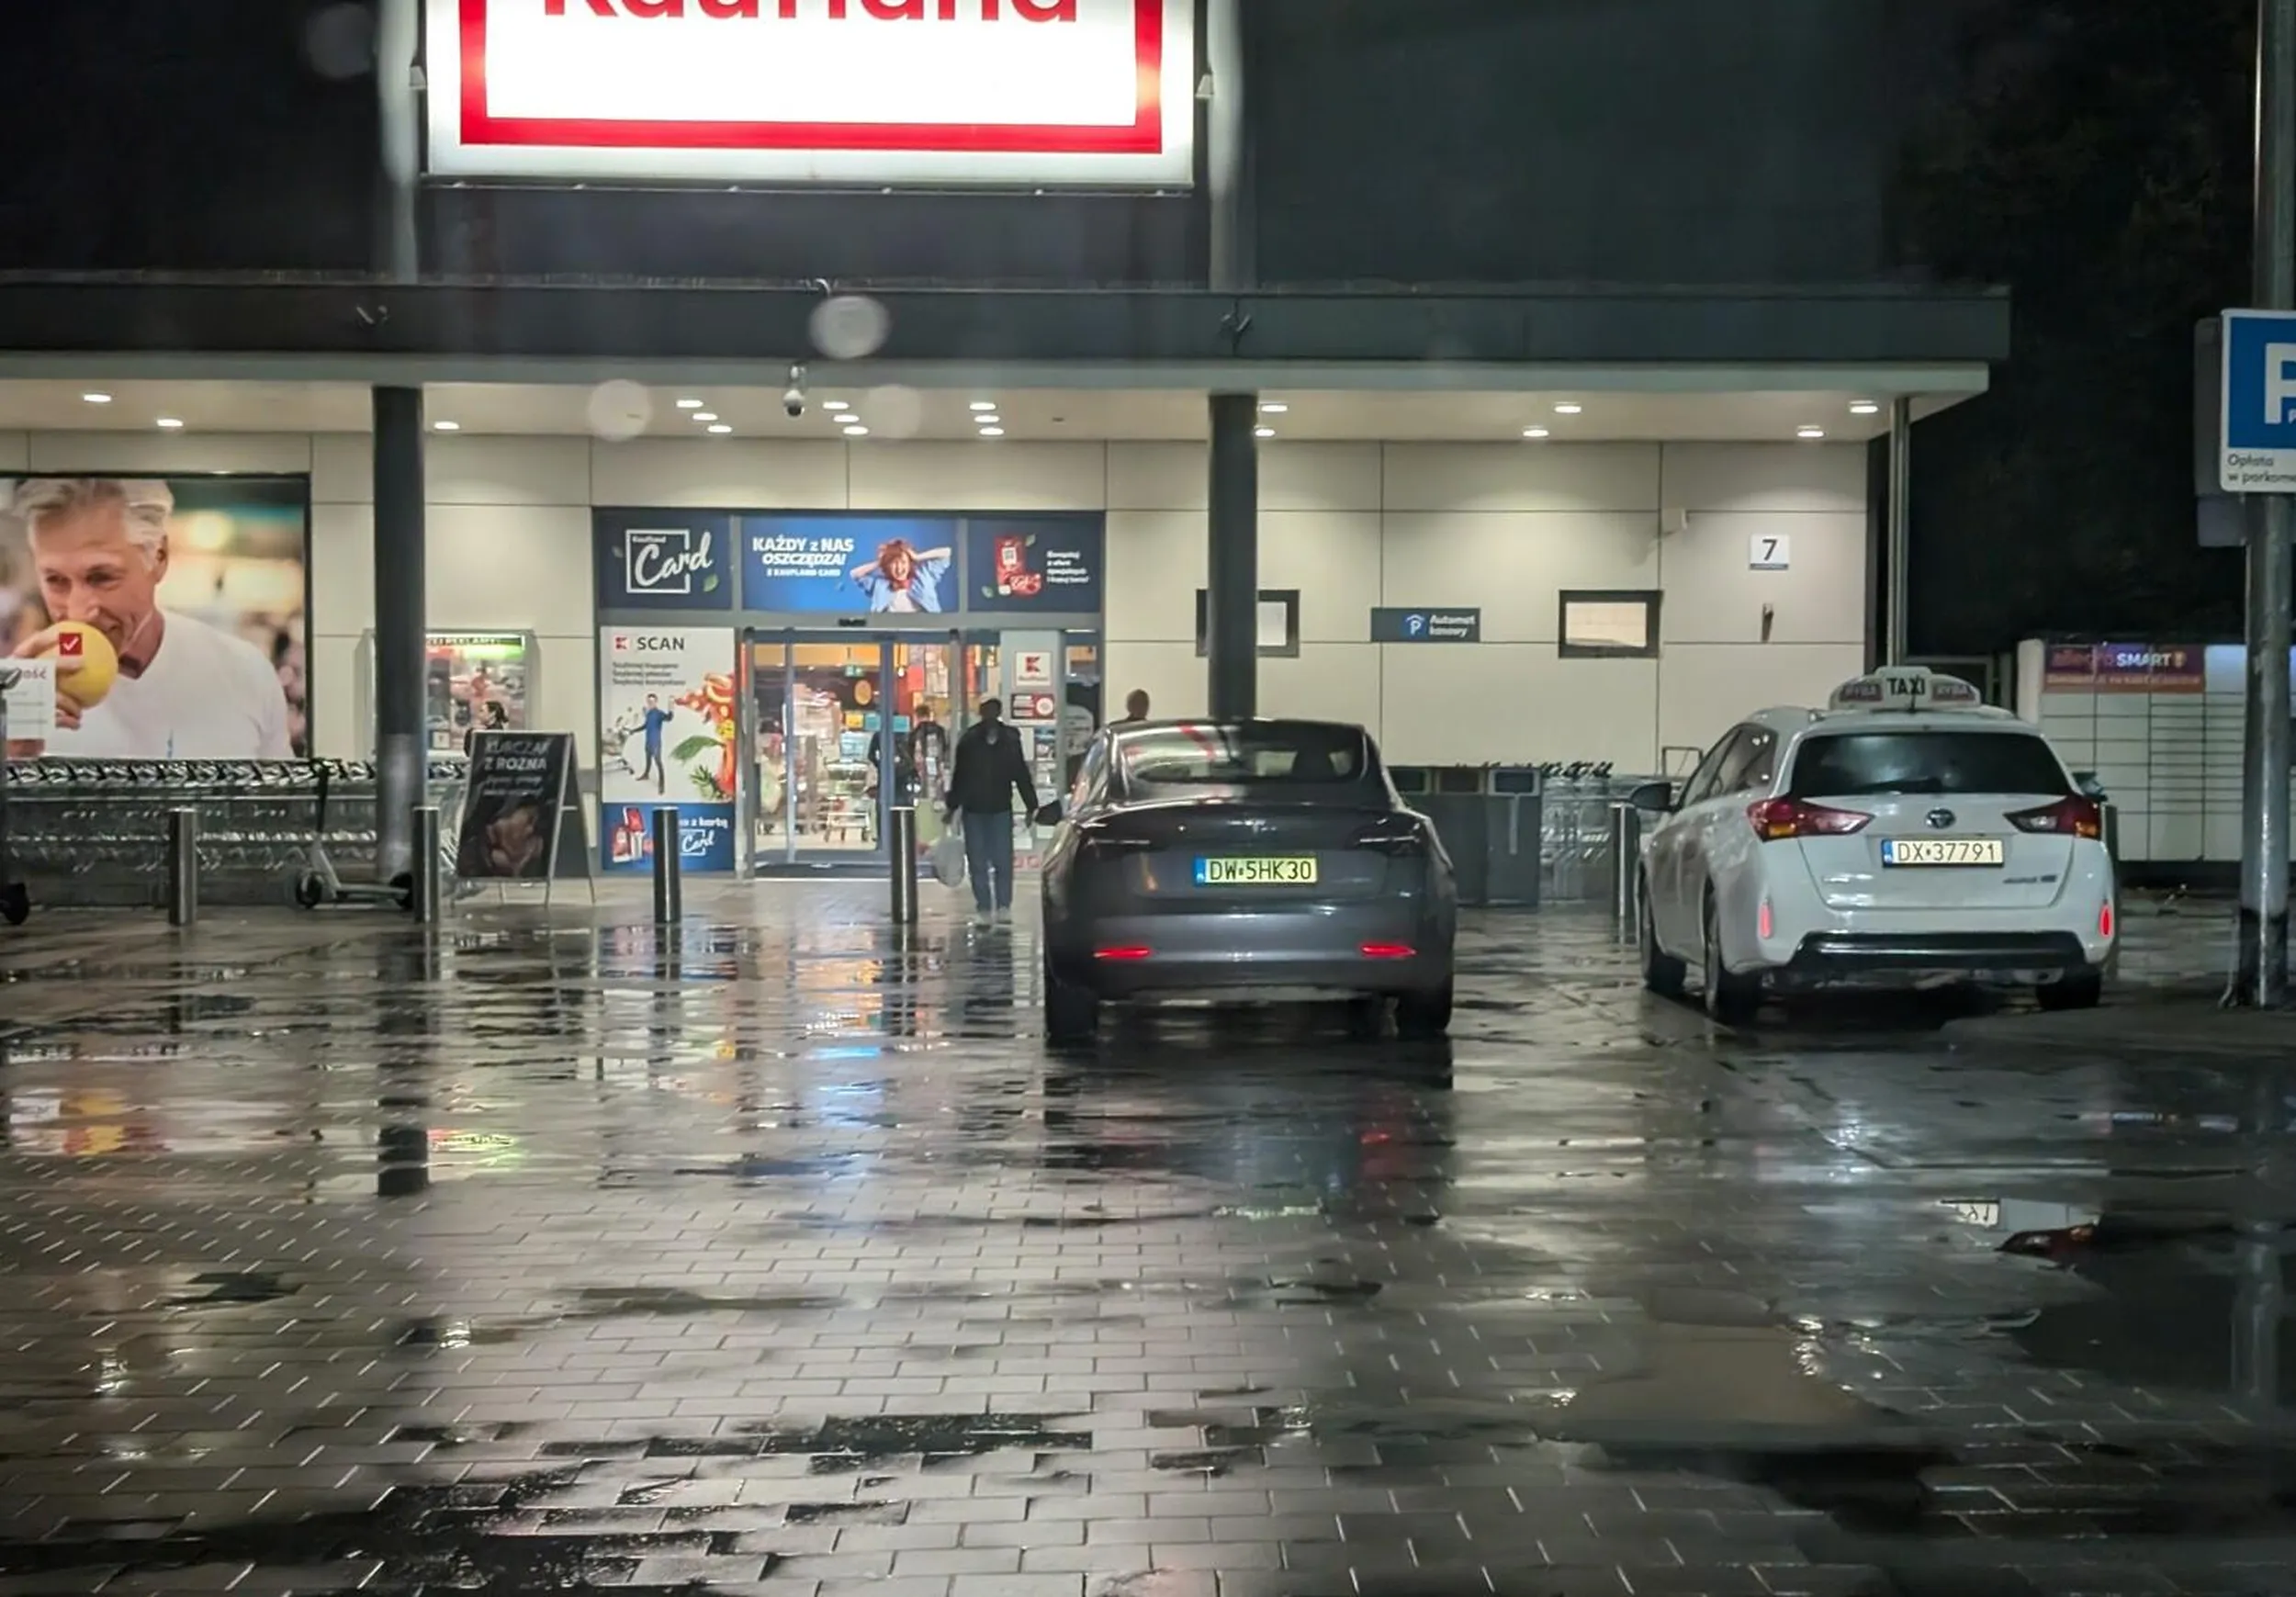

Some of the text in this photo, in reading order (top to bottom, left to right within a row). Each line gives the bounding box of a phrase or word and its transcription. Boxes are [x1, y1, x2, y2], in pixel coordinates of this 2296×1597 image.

[752, 534, 807, 552] KAŻDY
[821, 537, 855, 552] NAS
[1762, 538, 1778, 561] 7
[635, 531, 714, 587] Card
[636, 636, 685, 651] SCAN
[1886, 677, 1926, 696] TAXI
